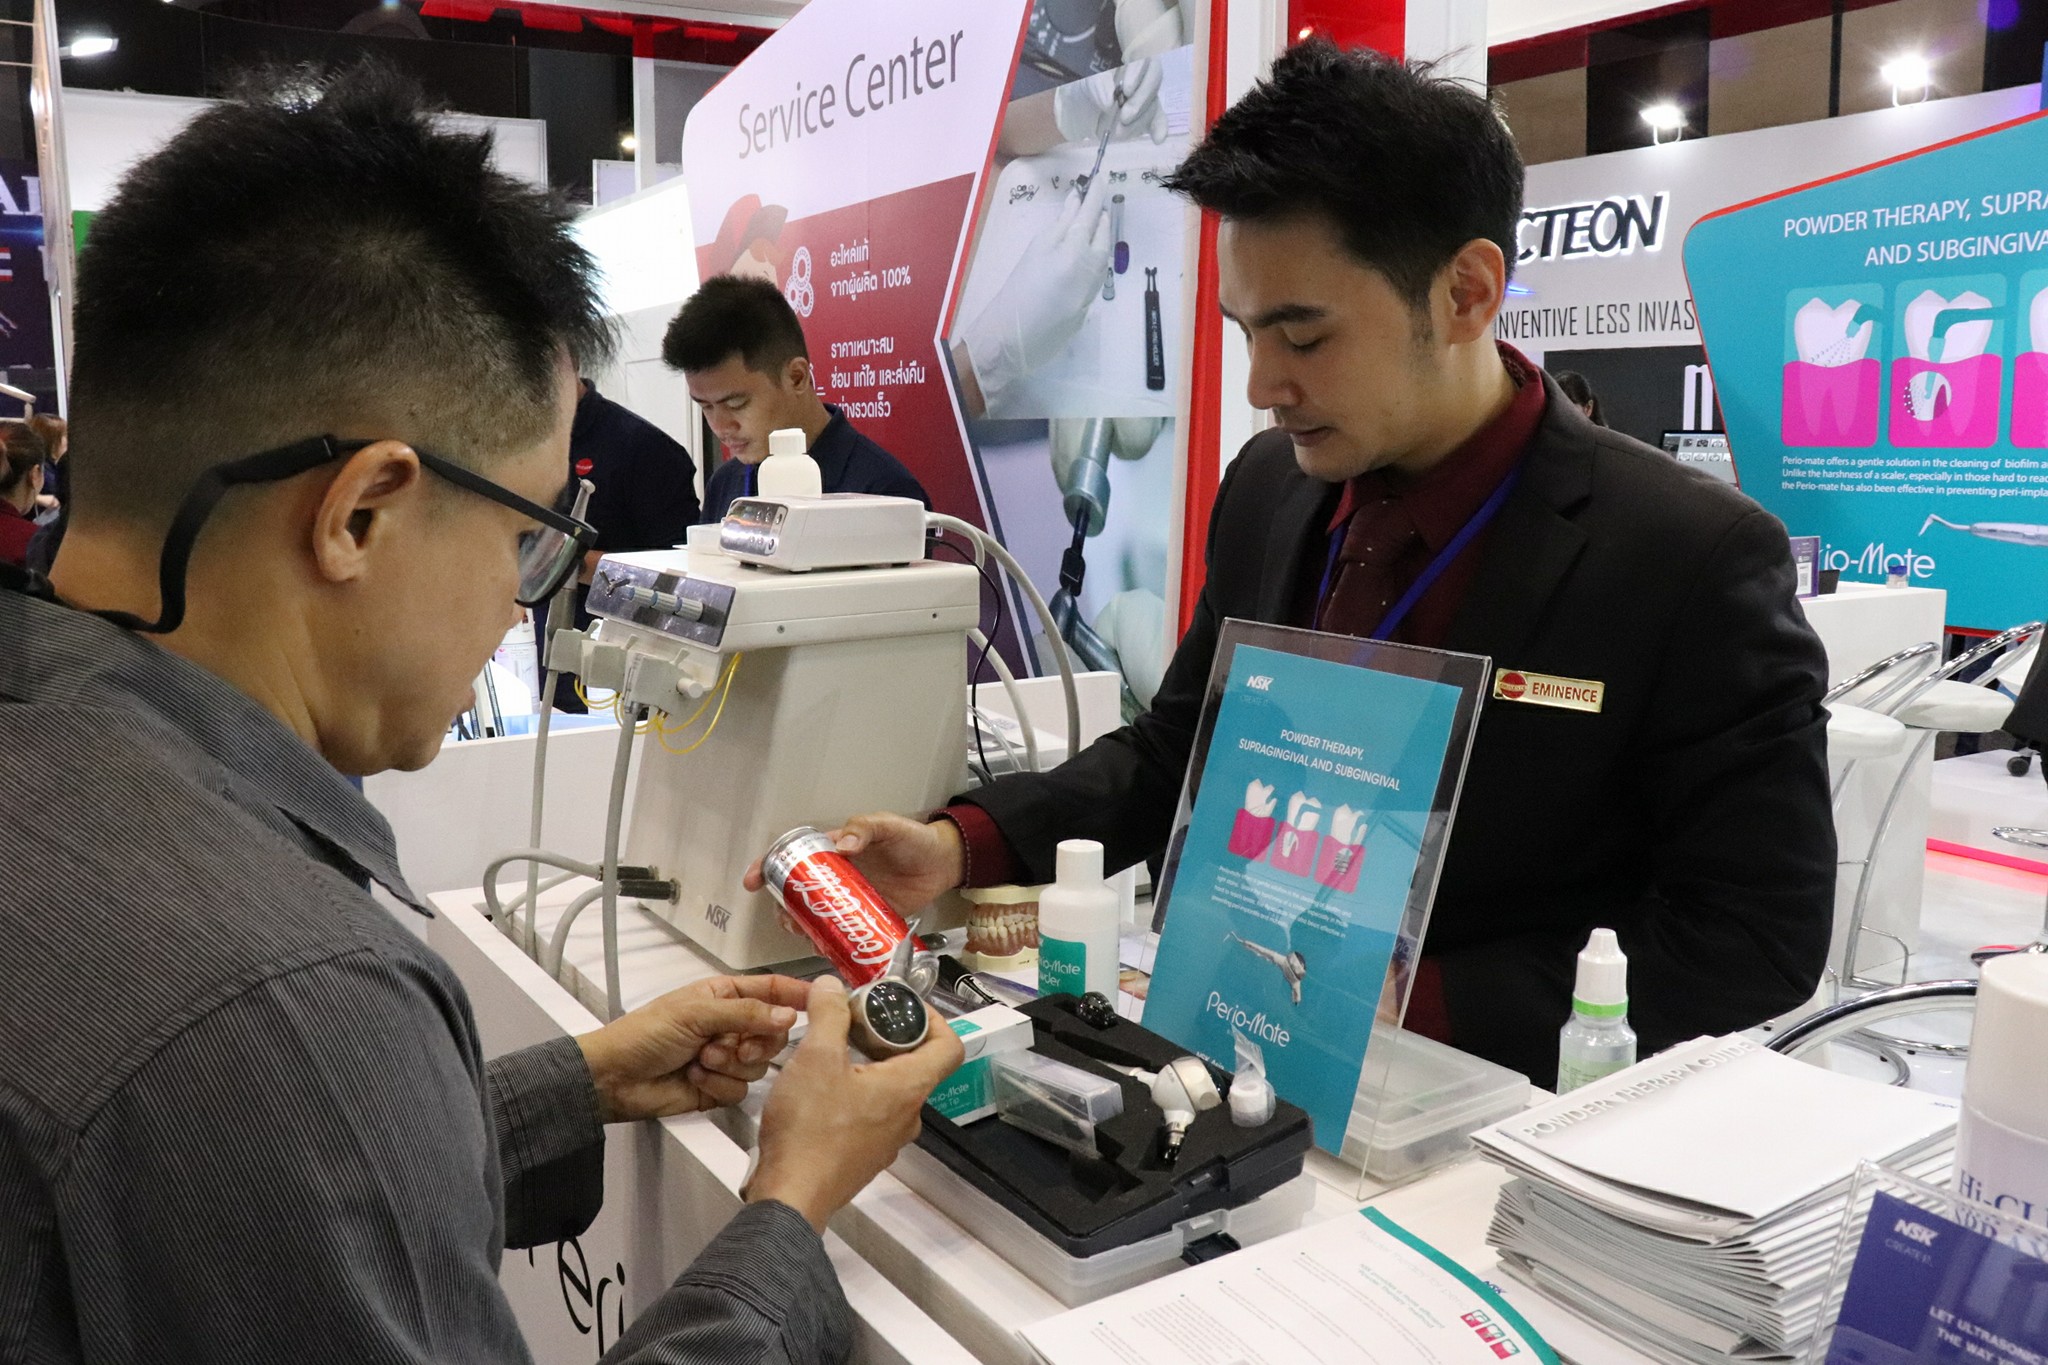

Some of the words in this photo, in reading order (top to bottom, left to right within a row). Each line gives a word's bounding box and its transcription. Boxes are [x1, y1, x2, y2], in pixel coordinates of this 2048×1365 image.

[739, 81, 836, 159] Service
[845, 29, 963, 118] Center
[1784, 211, 1867, 238] POWDER
[1872, 198, 1970, 228] THERAPY,
[831, 237, 869, 267] อะไหล่แท้
[1865, 244, 1911, 267] AND
[1916, 230, 2048, 263] SUBGINGIVA
[830, 271, 878, 302] จากผู้ผลิต
[882, 265, 911, 289] 100%
[1586, 304, 1630, 335] LESS
[831, 336, 894, 359] ราคาเหมาะสม
[834, 391, 891, 418] ่างรวดเร็ว
[1782, 456, 1825, 466] Perio-mate
[1826, 456, 1849, 466] offers
[1857, 457, 1884, 468] gentle
[1886, 457, 1920, 467] solution
[1922, 458, 1931, 467] in
[1932, 458, 1947, 467] the
[1949, 458, 1989, 470] cleaning
[1990, 458, 2001, 468] of
[2004, 459, 2039, 469] biofilm
[1782, 468, 1806, 478] Unlike
[1808, 469, 1821, 477] the
[1822, 469, 1862, 479] harshness
[1863, 470, 1874, 479] of
[1880, 470, 1908, 481] scaler,
[1909, 472, 1952, 483] especially
[1954, 472, 1963, 481] in
[1965, 472, 1990, 481] those
[1992, 473, 2015, 482] hard
[2016, 474, 2028, 482] to
[1781, 481, 1795, 490] the
[1795, 481, 1839, 491] Perio-mate
[1840, 483, 1854, 492] has
[1856, 483, 1872, 493] also
[1874, 484, 1895, 493] been
[1897, 484, 1934, 494] effective
[1936, 485, 1945, 494] in
[1946, 486, 1997, 497] preventing
[1820, 542, 1936, 579] io-Mate
[1247, 675, 1274, 691] NSK
[1532, 682, 1598, 703] EMINENCE
[1280, 729, 1321, 749] POWDER
[1321, 739, 1364, 760] THERAPY,
[1238, 738, 1309, 767] SUPRAGINGIVAL
[1311, 758, 1333, 772] AND
[1334, 763, 1400, 791] SUBGINGIVAL
[705, 903, 732, 933] NSK
[787, 862, 896, 965] Coca-Cola
[1206, 991, 1290, 1047] Perio-Mate
[927, 1083, 970, 1103] erio-Mate
[1521, 1099, 1613, 1139] POWDER
[1611, 1062, 1698, 1108] THERAPY
[1698, 1039, 1757, 1070] GUIDE
[1893, 1219, 1939, 1247] NSK
[1929, 1305, 1955, 1324] LET
[1957, 1317, 2041, 1363] ULTRASONIC
[1937, 1327, 1963, 1348] THE
[1965, 1342, 1994, 1362] WAY
